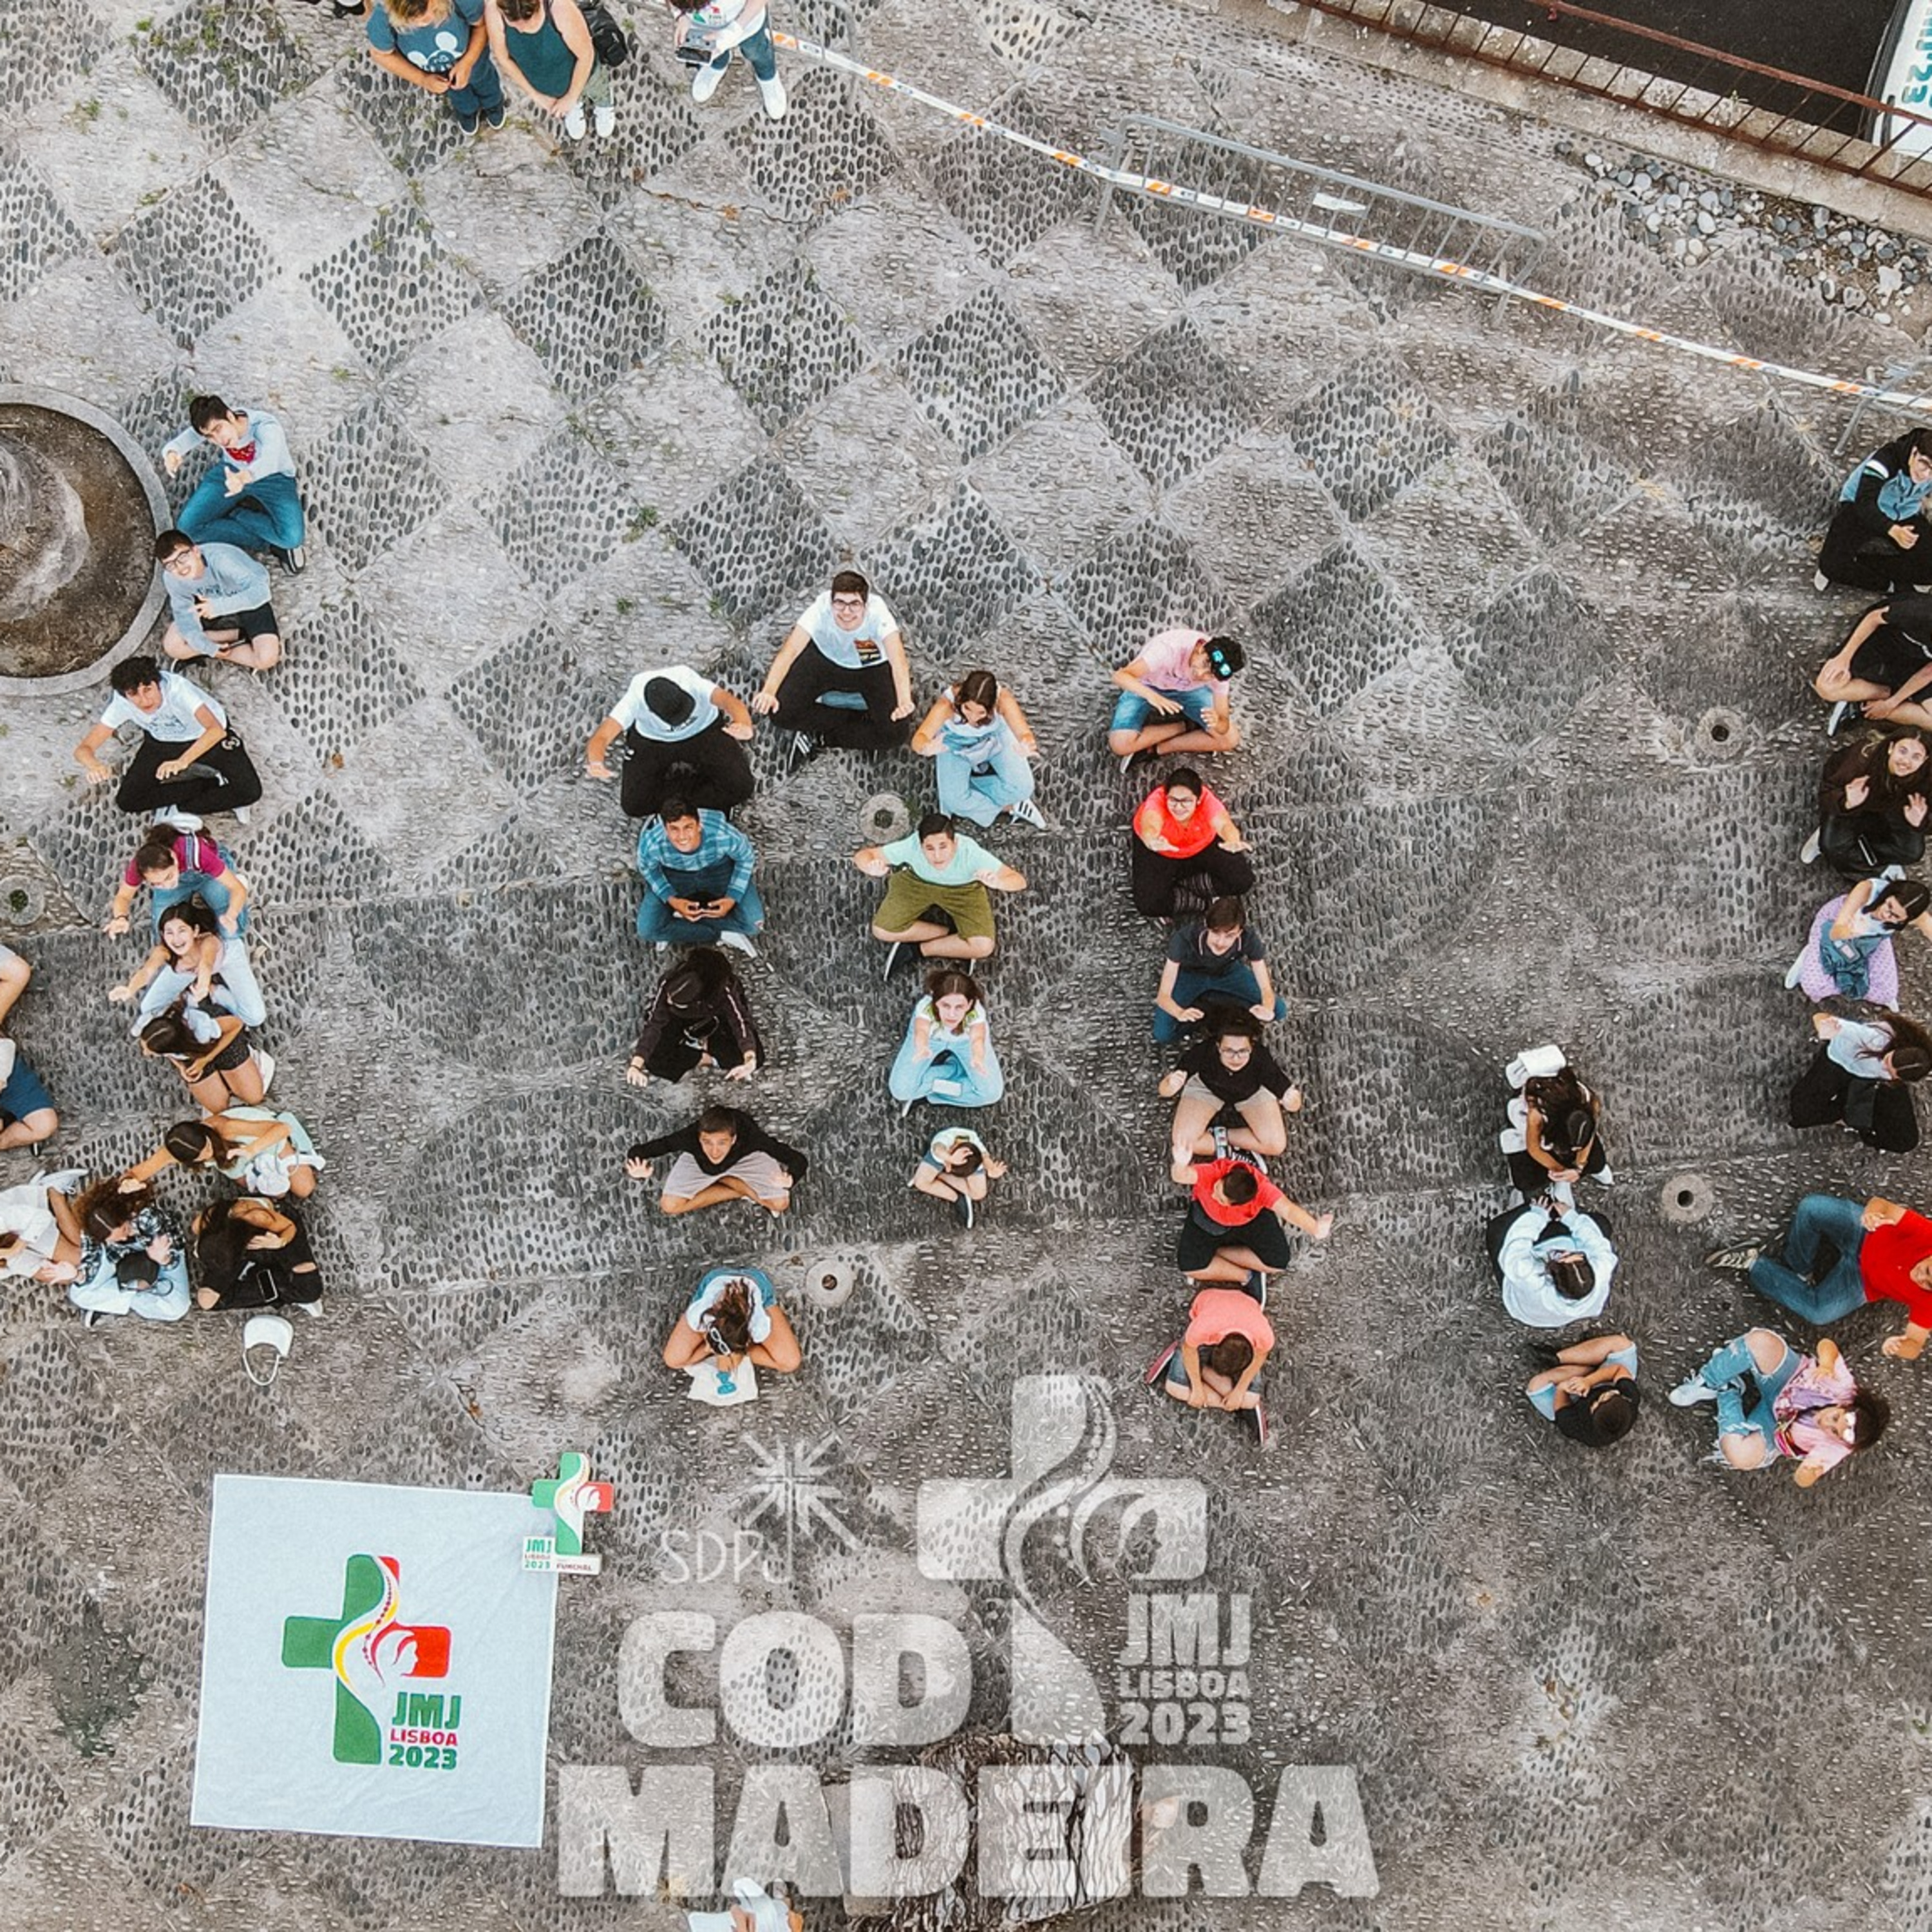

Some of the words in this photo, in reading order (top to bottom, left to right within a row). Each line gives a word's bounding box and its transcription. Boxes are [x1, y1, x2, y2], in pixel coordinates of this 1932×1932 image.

[526, 1539, 551, 1553] JMJ
[392, 1692, 462, 1729] JMJ
[390, 1728, 459, 1747] LISBOA
[388, 1744, 458, 1770] 2023
